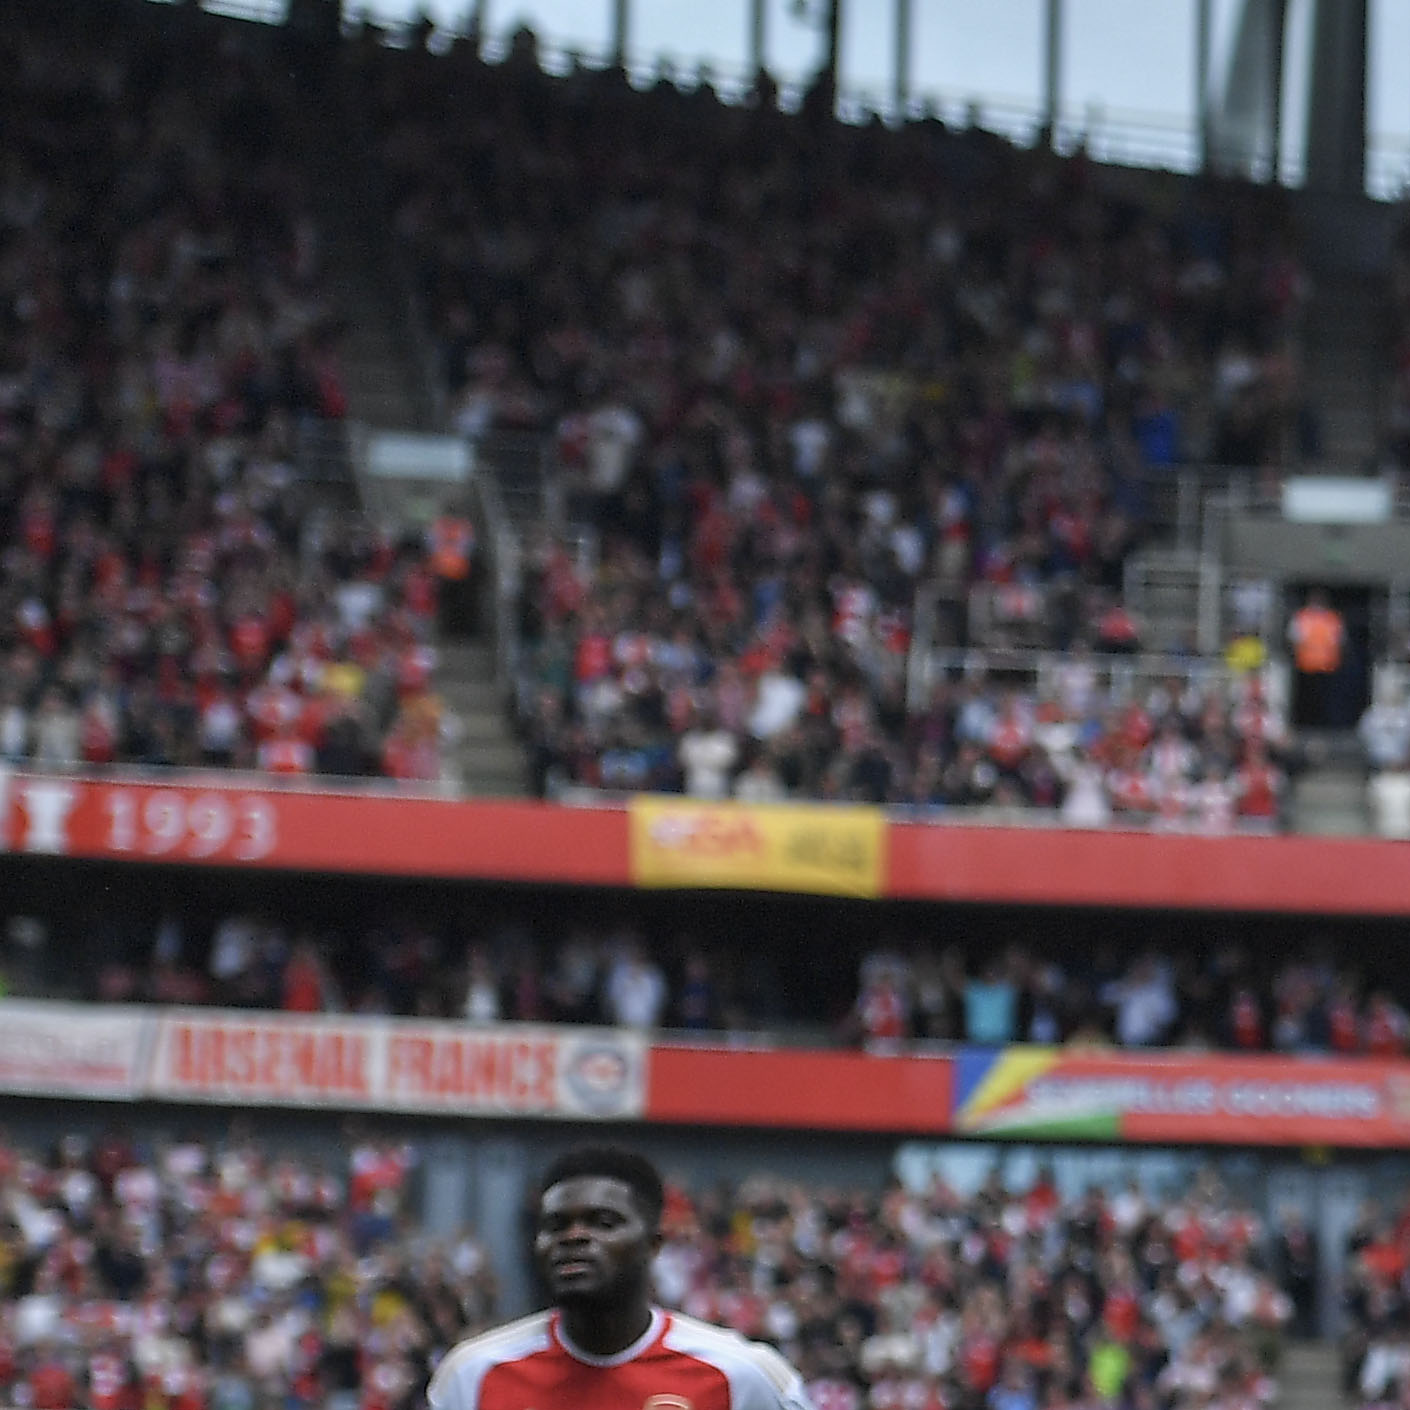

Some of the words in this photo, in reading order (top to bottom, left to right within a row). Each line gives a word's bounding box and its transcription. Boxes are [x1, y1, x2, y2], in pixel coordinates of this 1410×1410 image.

[104, 790, 278, 861] 1993
[174, 1025, 370, 1096] ARSENAL
[389, 1039, 559, 1110] FRANCE
